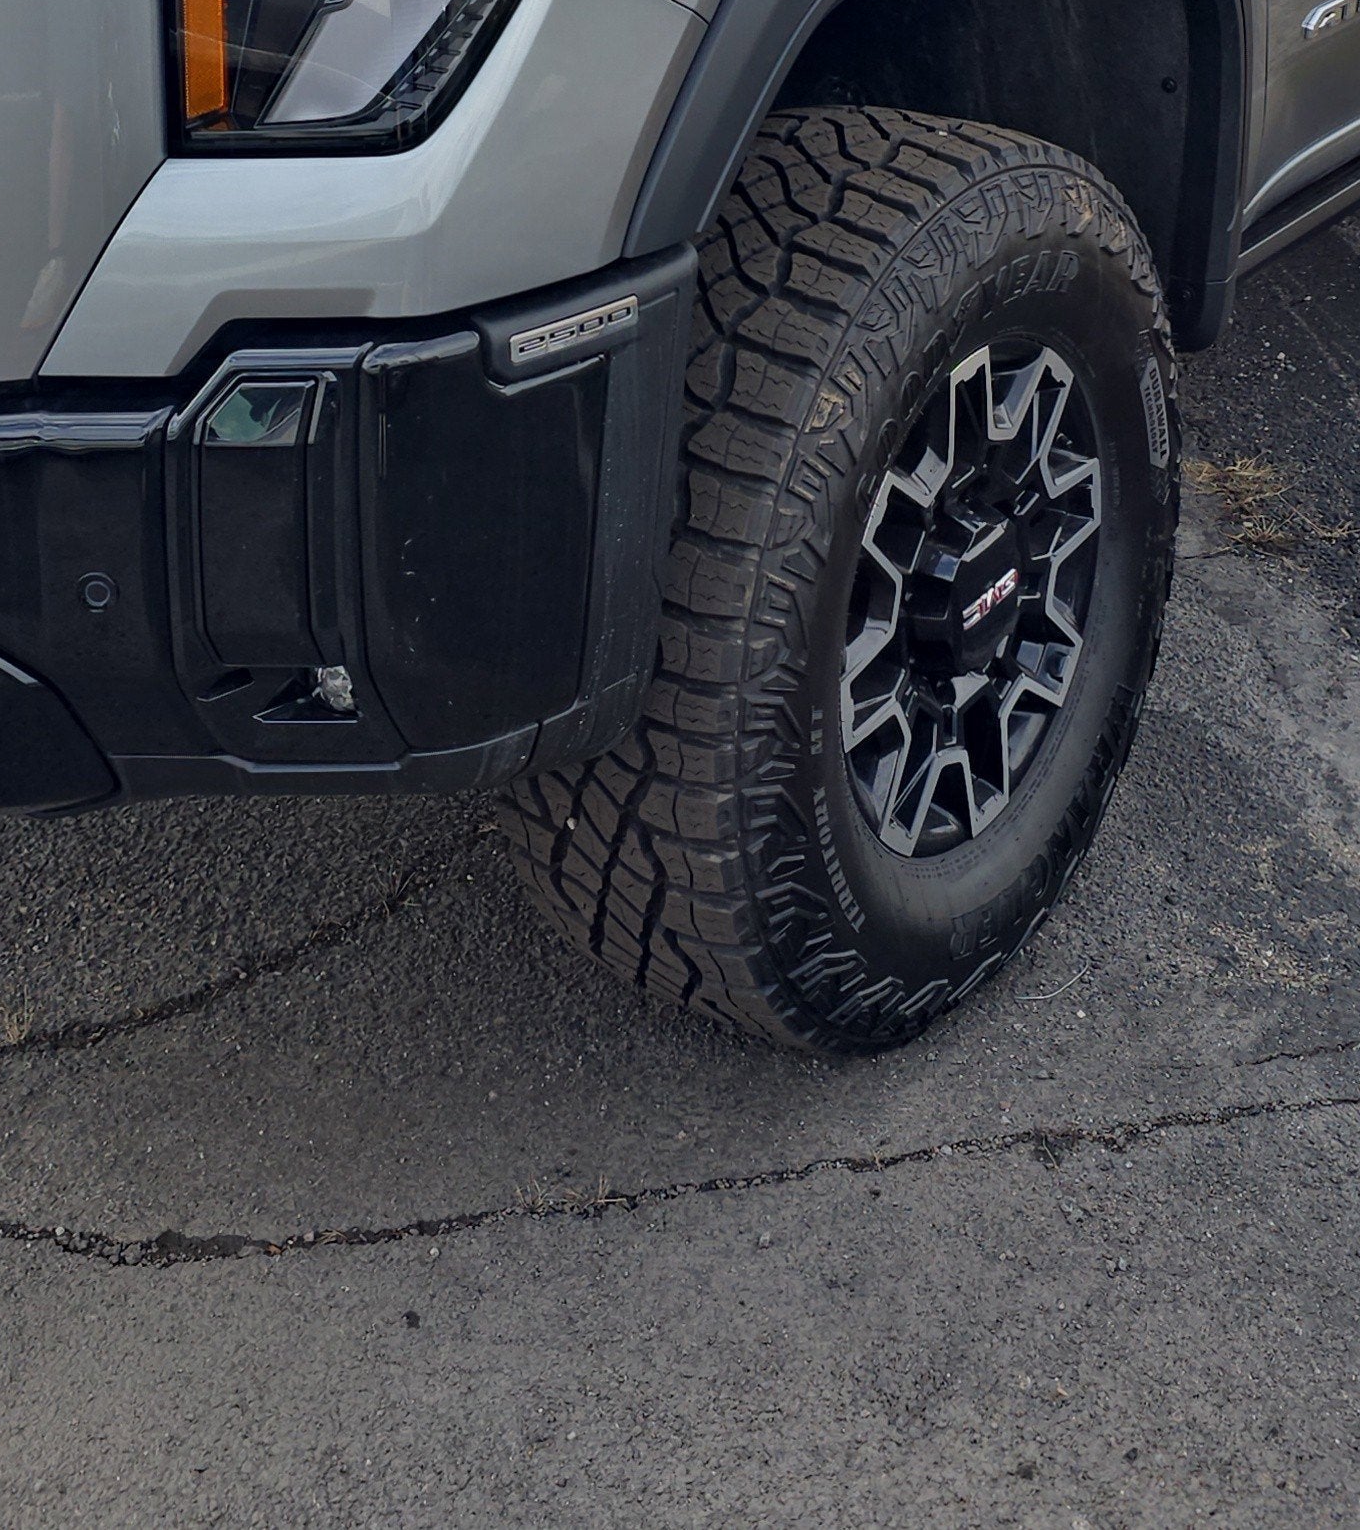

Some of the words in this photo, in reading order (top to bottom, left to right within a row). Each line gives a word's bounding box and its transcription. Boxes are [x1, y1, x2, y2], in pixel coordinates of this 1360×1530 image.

[518, 305, 632, 354] 2500
[1143, 386, 1159, 454] TECHNOLOGY
[1149, 369, 1168, 460] DURAWALL
[962, 568, 1018, 630] GMC
[813, 787, 866, 933] TERRITORY
